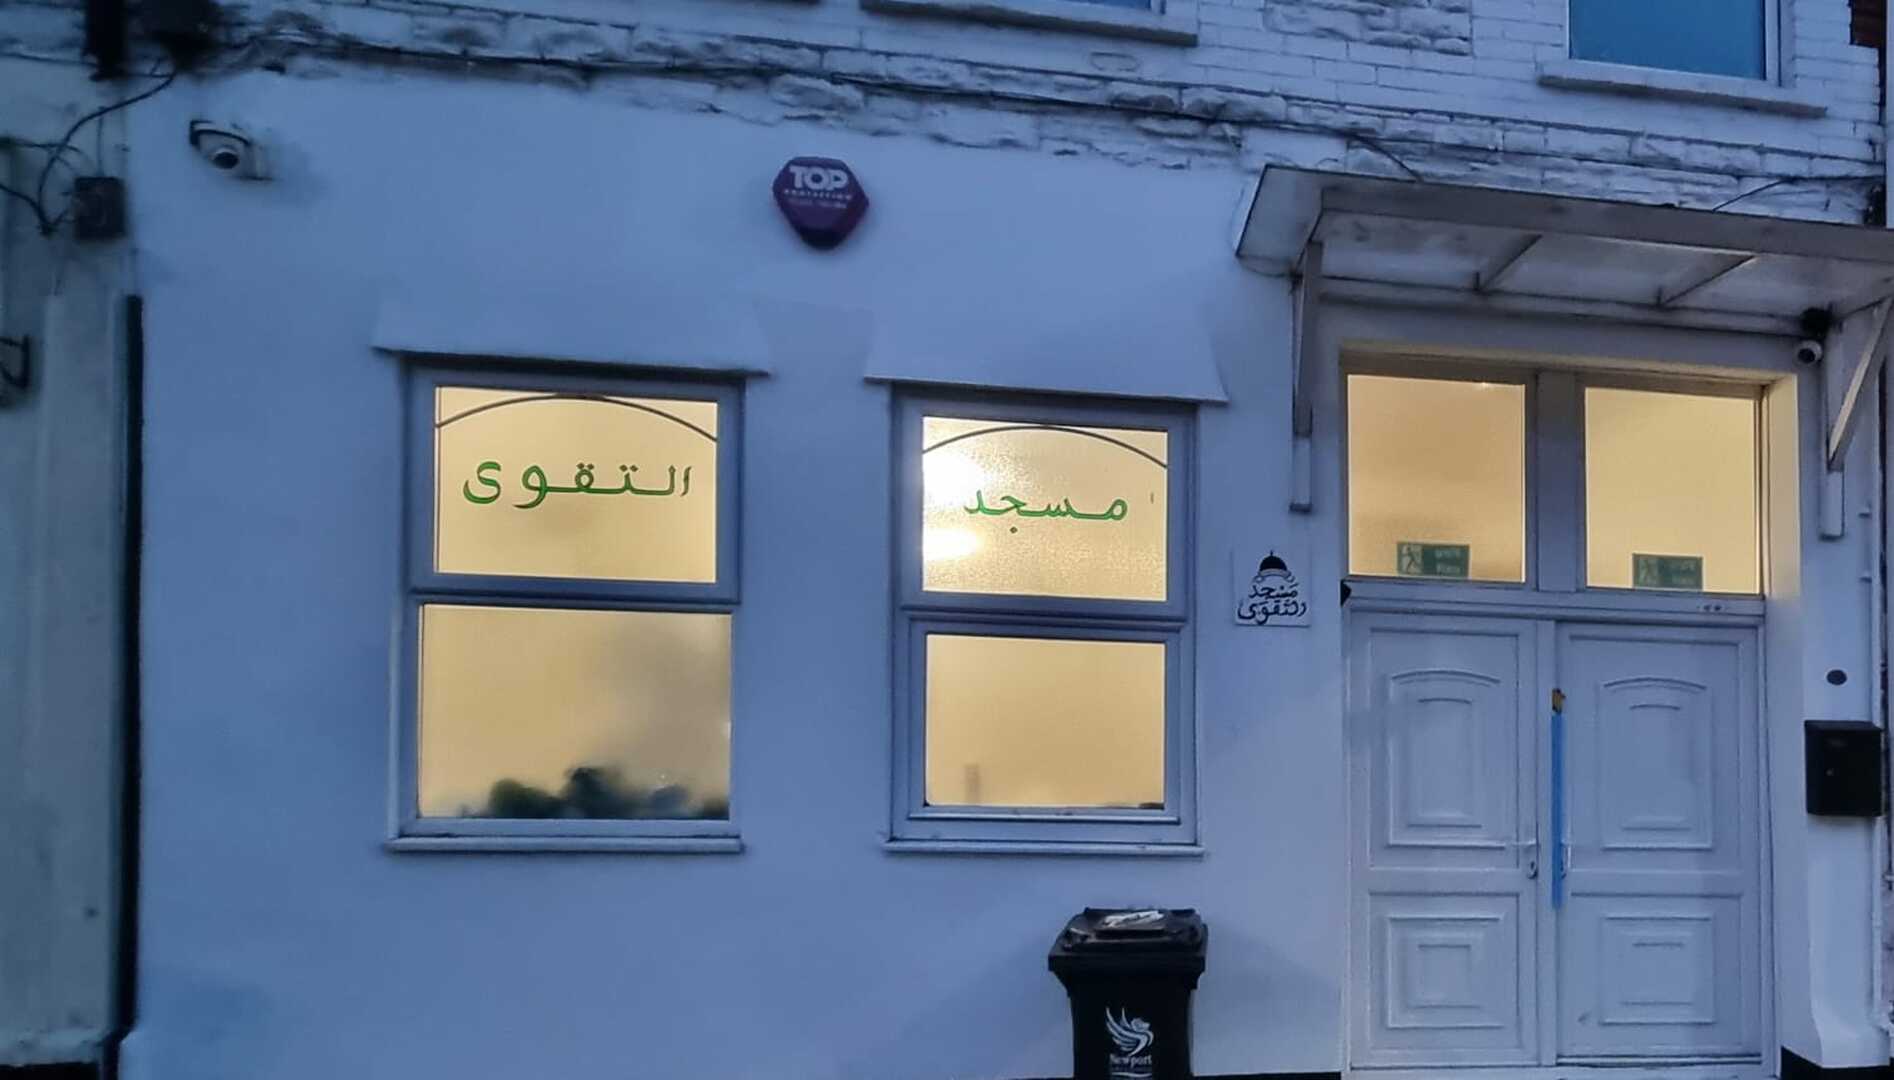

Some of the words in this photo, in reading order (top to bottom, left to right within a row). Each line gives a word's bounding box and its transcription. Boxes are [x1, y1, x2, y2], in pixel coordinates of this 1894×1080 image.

[789, 164, 849, 191] TOP
[463, 461, 692, 509] التقوى
[963, 490, 1128, 534] مسجد
[1109, 1054, 1152, 1069] Newport
